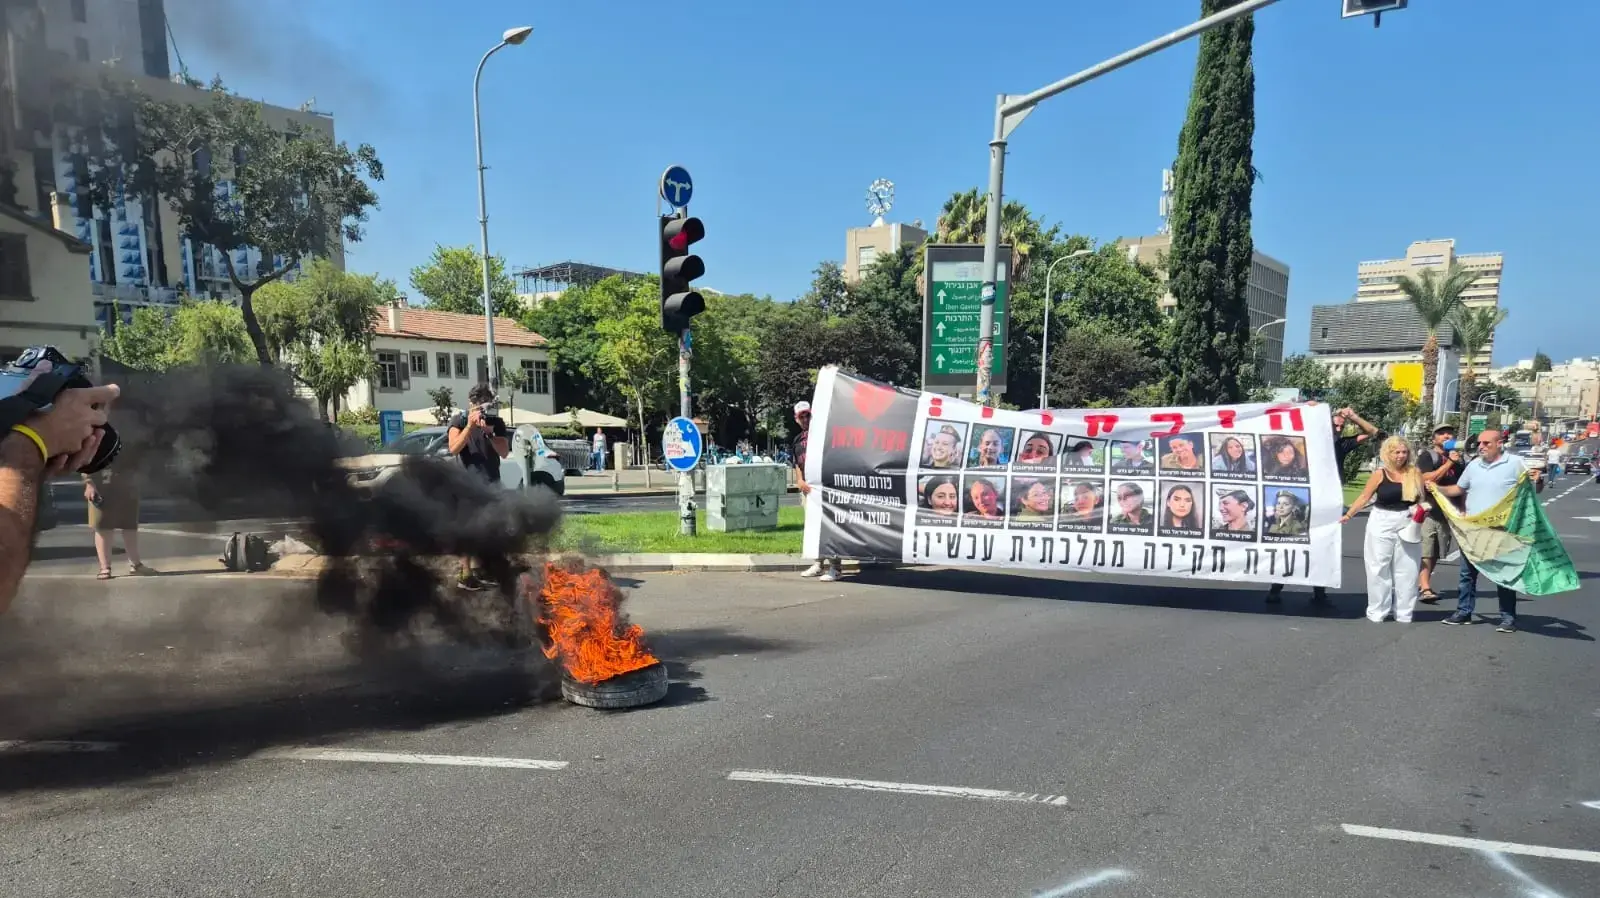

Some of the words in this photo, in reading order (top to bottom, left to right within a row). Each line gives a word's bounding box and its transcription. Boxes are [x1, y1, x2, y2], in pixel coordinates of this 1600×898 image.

[834, 473, 867, 489] משפחות
[869, 476, 892, 490] פורום
[912, 528, 995, 562] עכשיו!
[1009, 532, 1125, 568] ממלכתית
[1143, 541, 1226, 575] חקירה
[1245, 547, 1310, 578] ועדת
